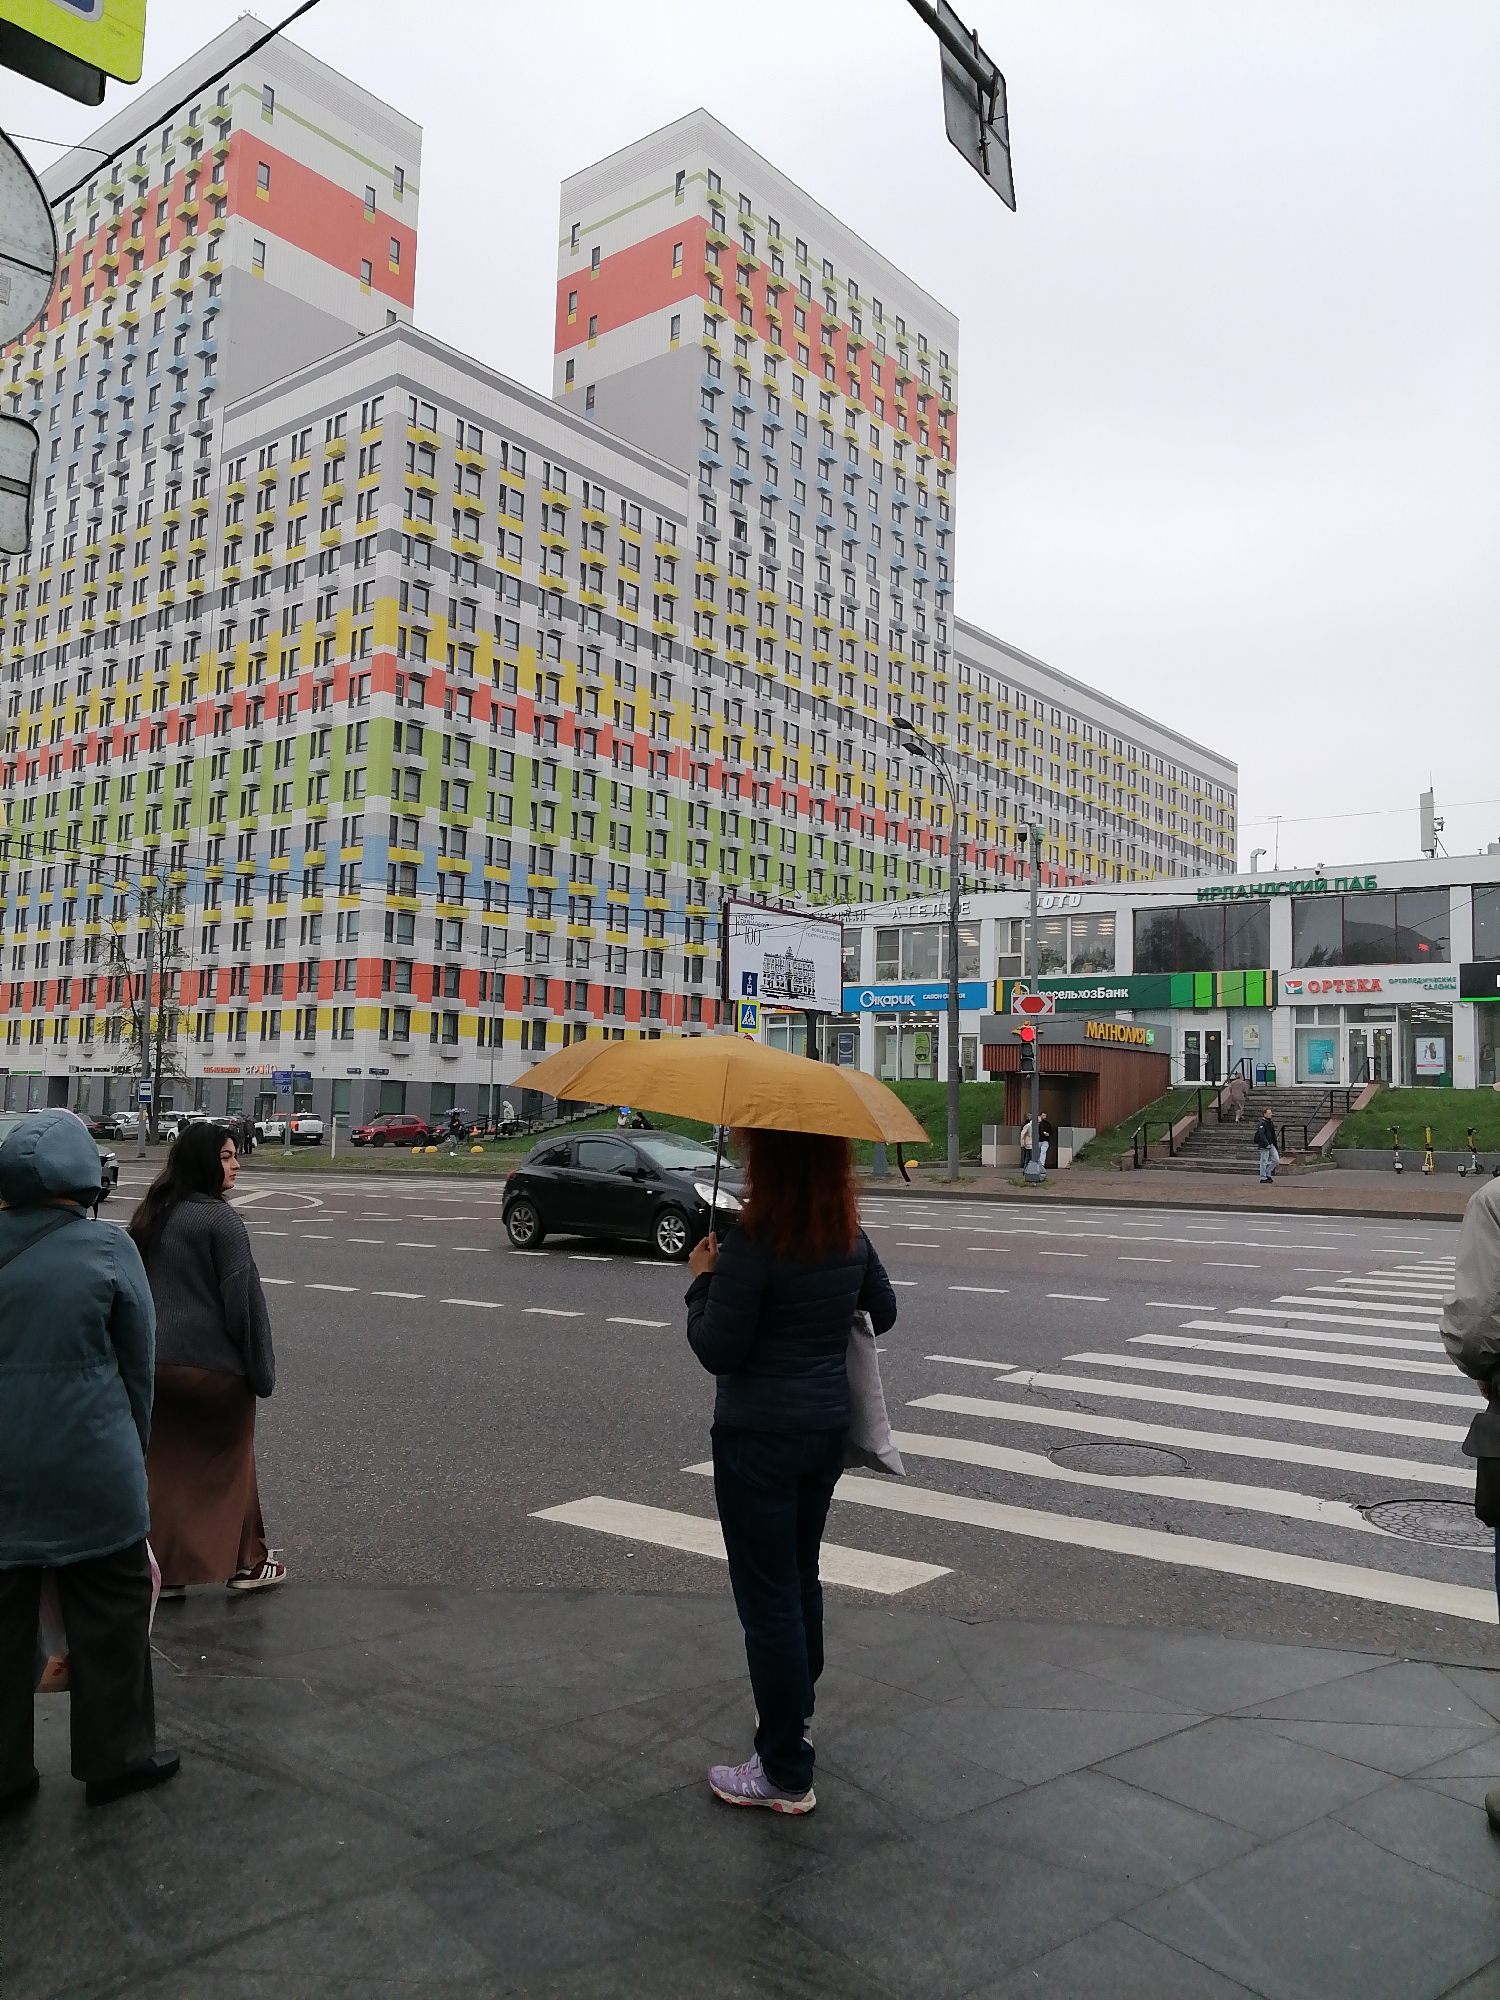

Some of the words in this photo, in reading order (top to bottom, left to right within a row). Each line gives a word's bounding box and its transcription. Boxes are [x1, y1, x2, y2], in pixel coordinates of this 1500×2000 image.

[1197, 878, 1328, 901] ИРЛАНДСКИЙ
[1334, 875, 1377, 891] ПАБ
[1307, 978, 1383, 993] ОРТЕКА
[1086, 1021, 1146, 1044] МАГНОЛИЯ
